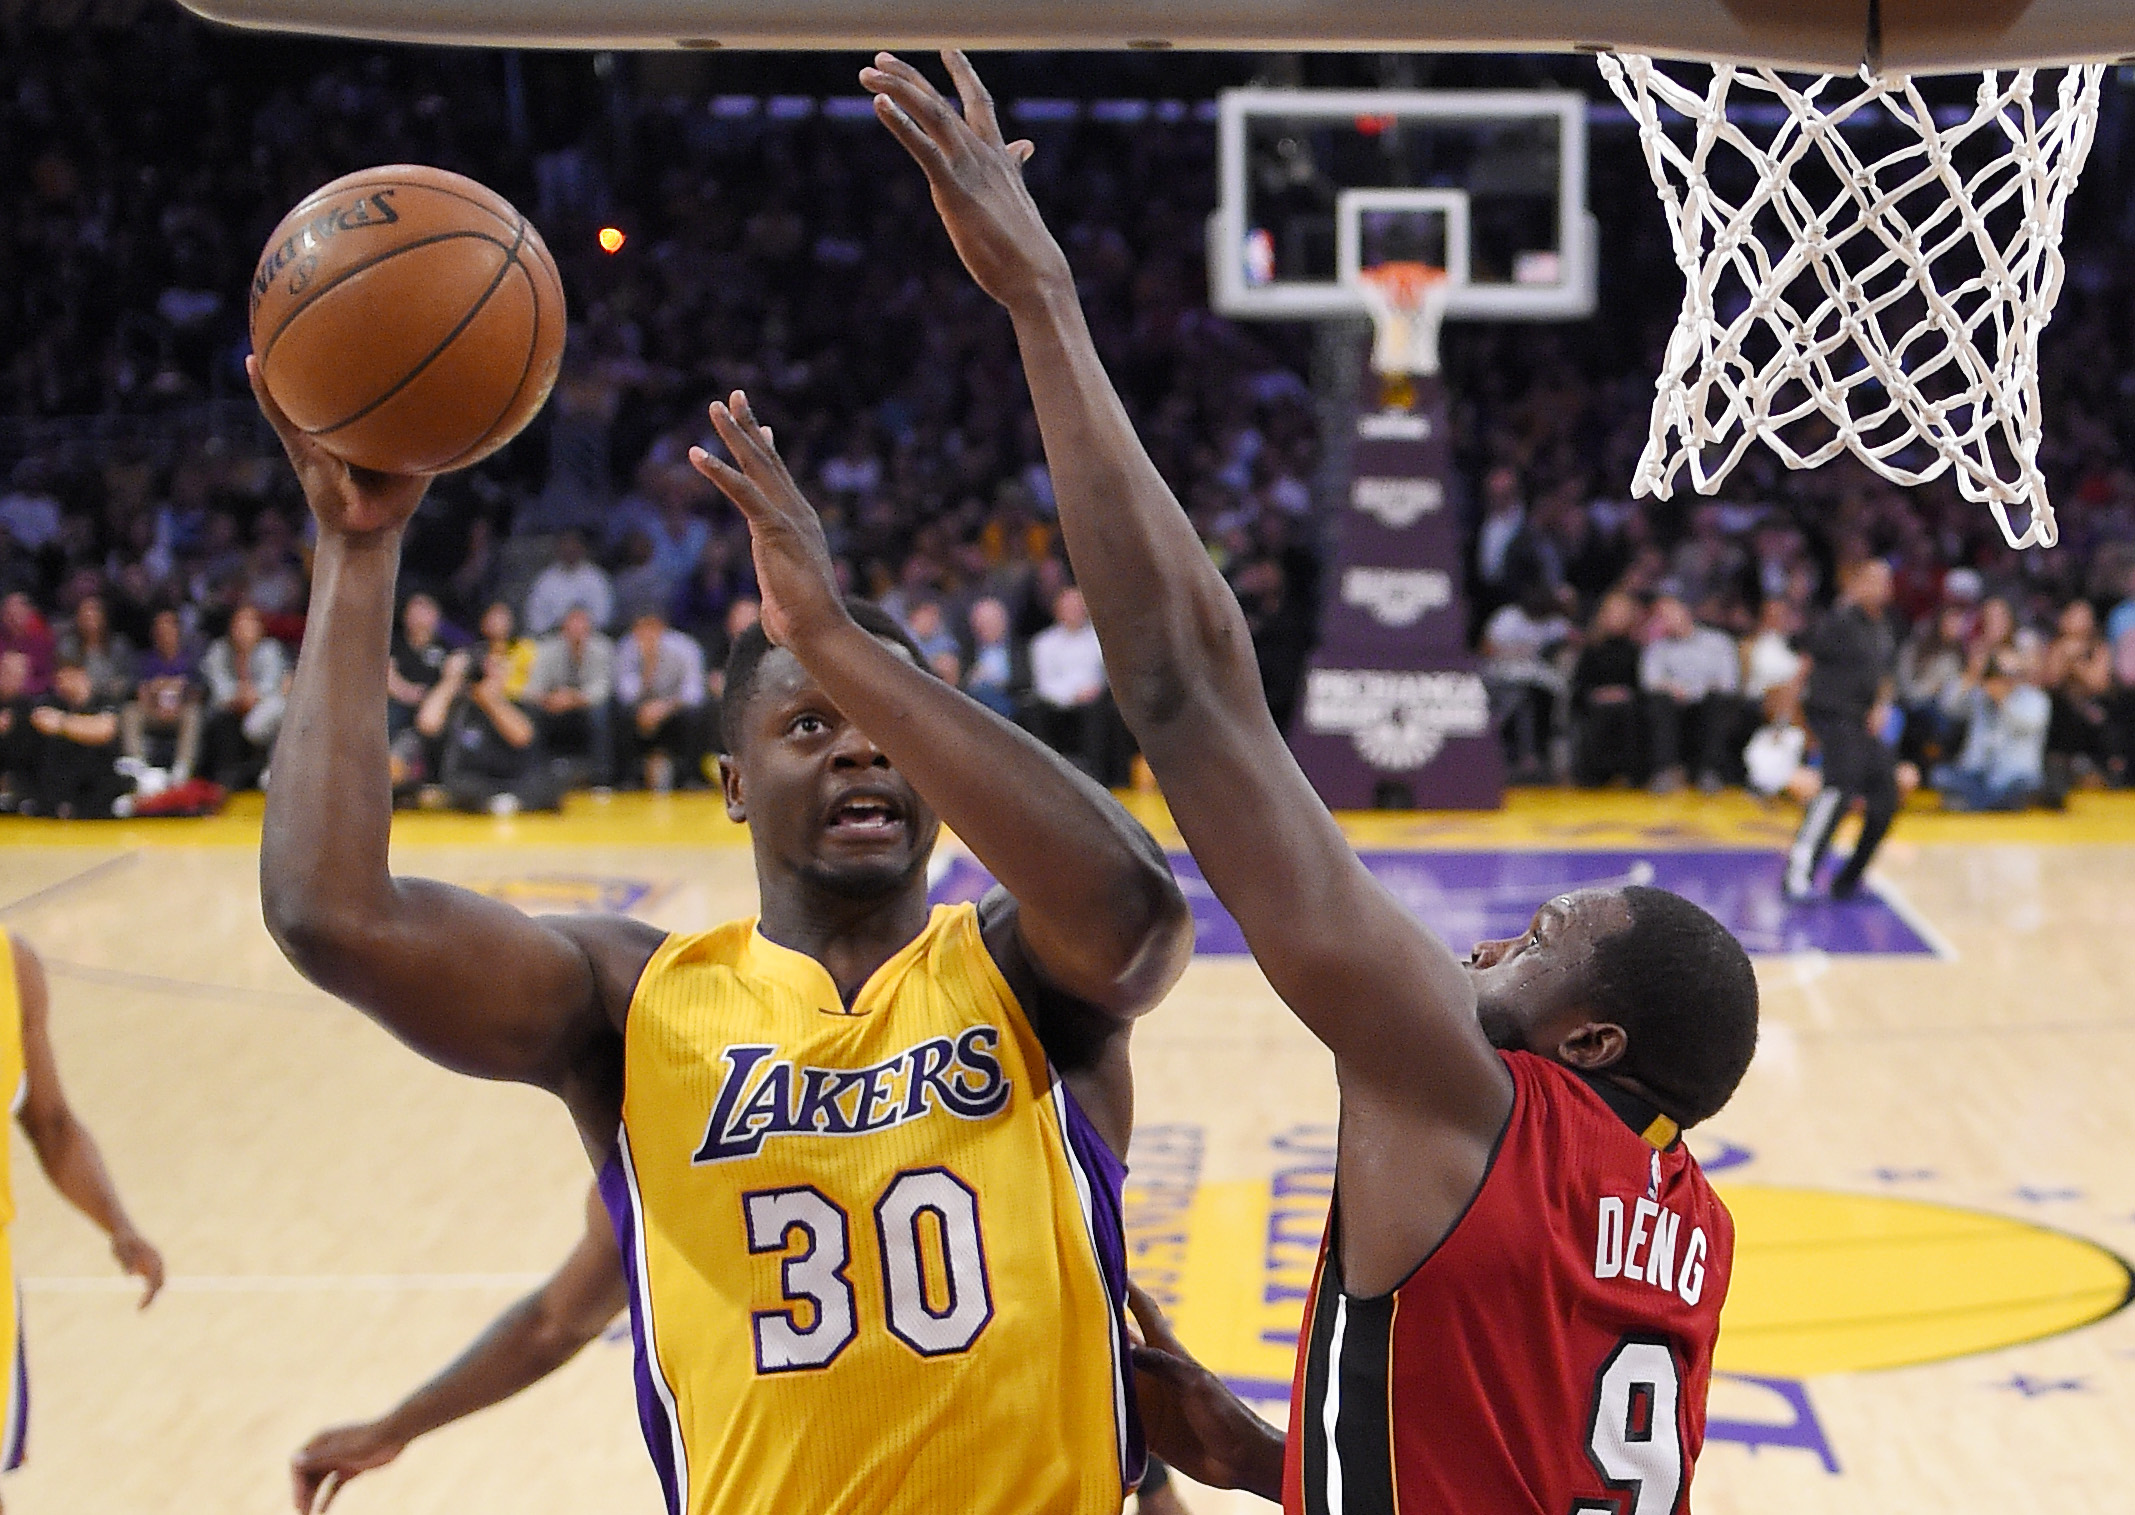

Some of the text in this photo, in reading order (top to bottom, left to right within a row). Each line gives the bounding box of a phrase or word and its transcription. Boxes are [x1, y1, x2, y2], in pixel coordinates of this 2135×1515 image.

[690, 1024, 1014, 1166] LAKERS
[742, 1166, 995, 1375] 30
[1595, 1196, 1707, 1307] DENG
[1569, 1333, 1686, 1515] 9
